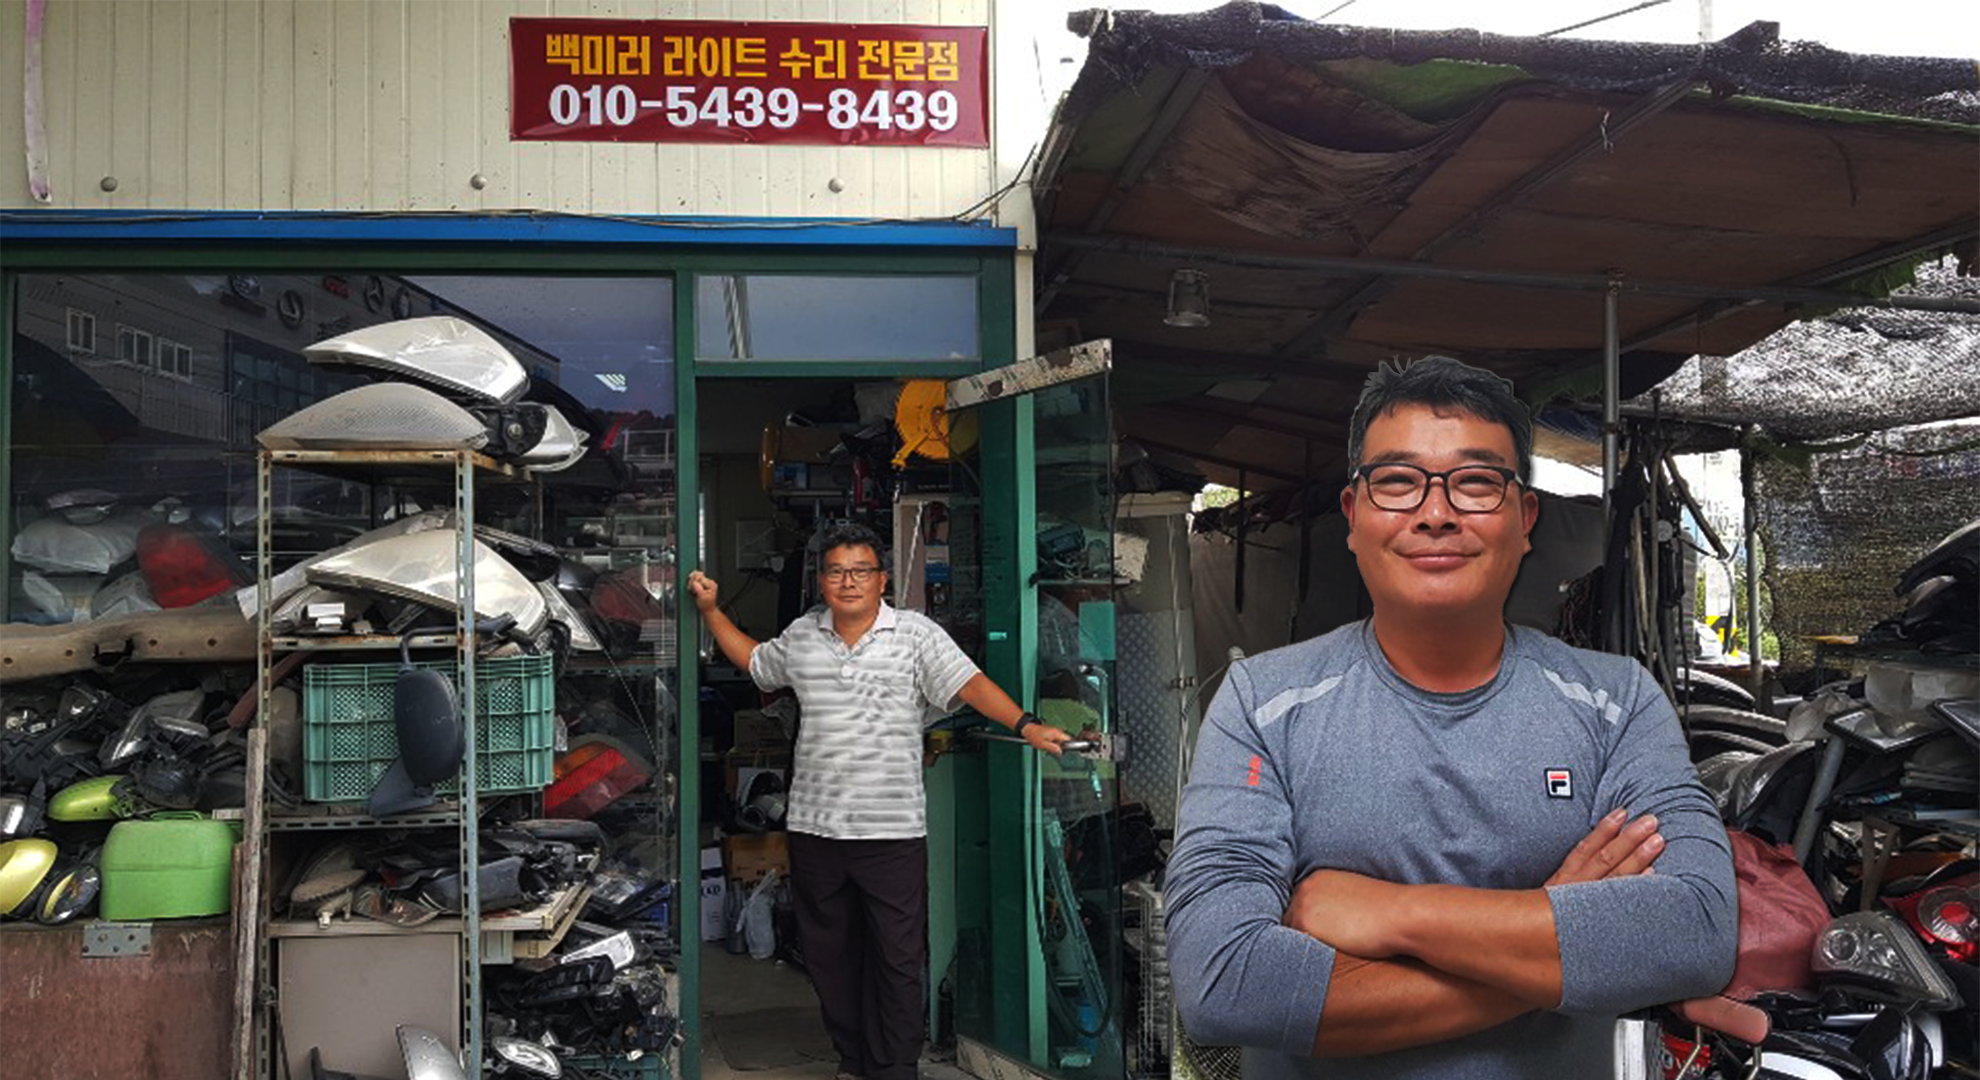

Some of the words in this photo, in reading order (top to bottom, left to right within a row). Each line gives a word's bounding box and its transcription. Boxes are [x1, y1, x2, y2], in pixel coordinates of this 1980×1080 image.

[546, 34, 651, 75] 백미러
[664, 36, 767, 77] 라이트
[779, 38, 847, 80] 수리
[857, 40, 959, 82] 전문점
[549, 84, 959, 131] 010-5439-8439
